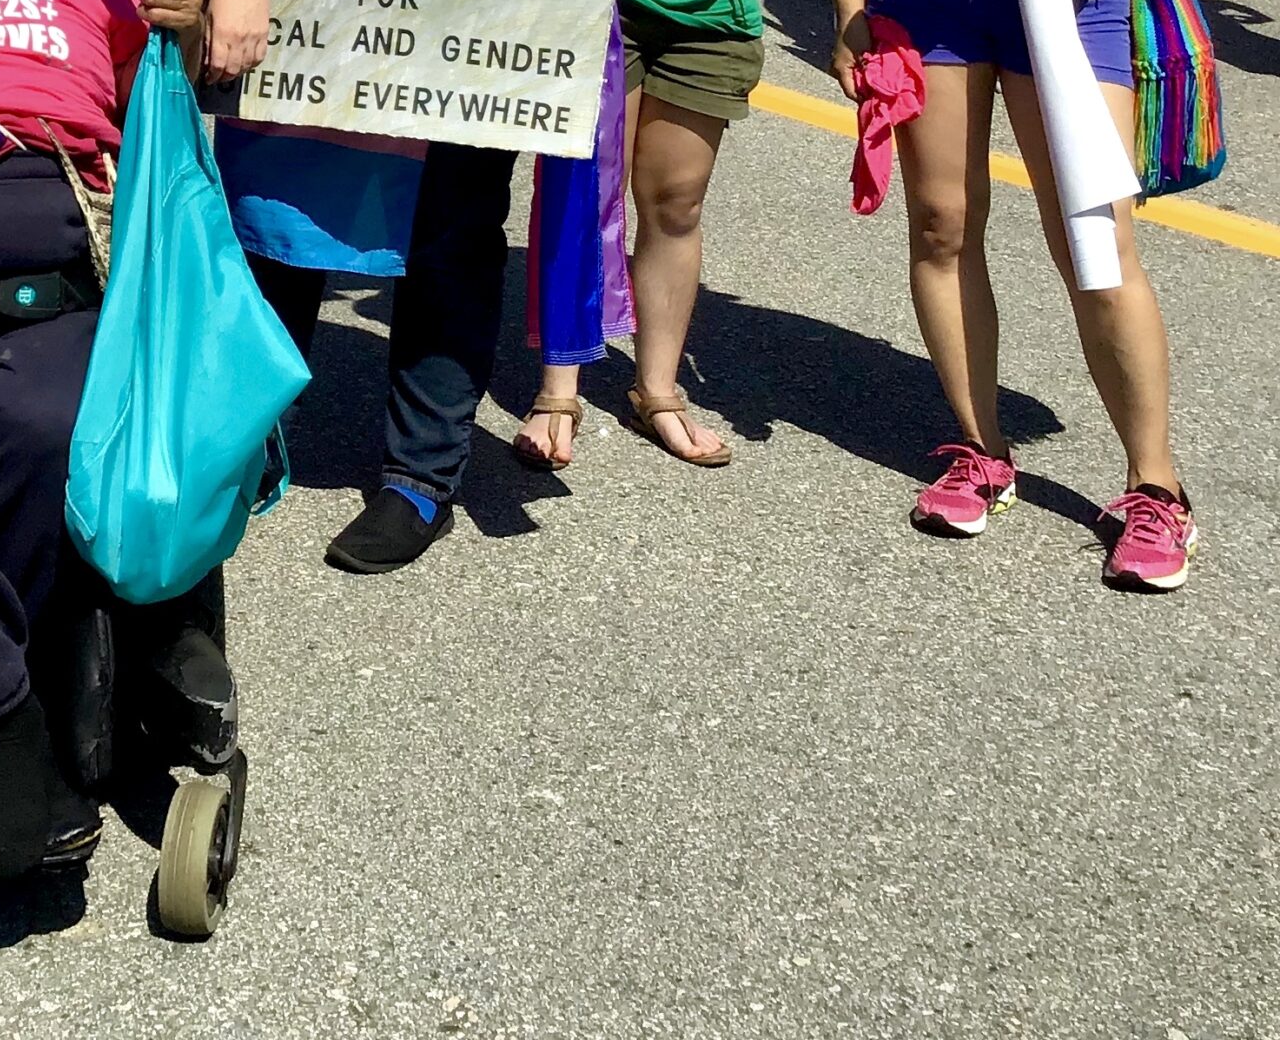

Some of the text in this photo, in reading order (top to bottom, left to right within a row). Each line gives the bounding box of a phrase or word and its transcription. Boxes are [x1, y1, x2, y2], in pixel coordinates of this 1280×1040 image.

[351, 25, 416, 57] AND
[441, 35, 576, 79] GENDER
[353, 80, 571, 135] EVERYWHERE
